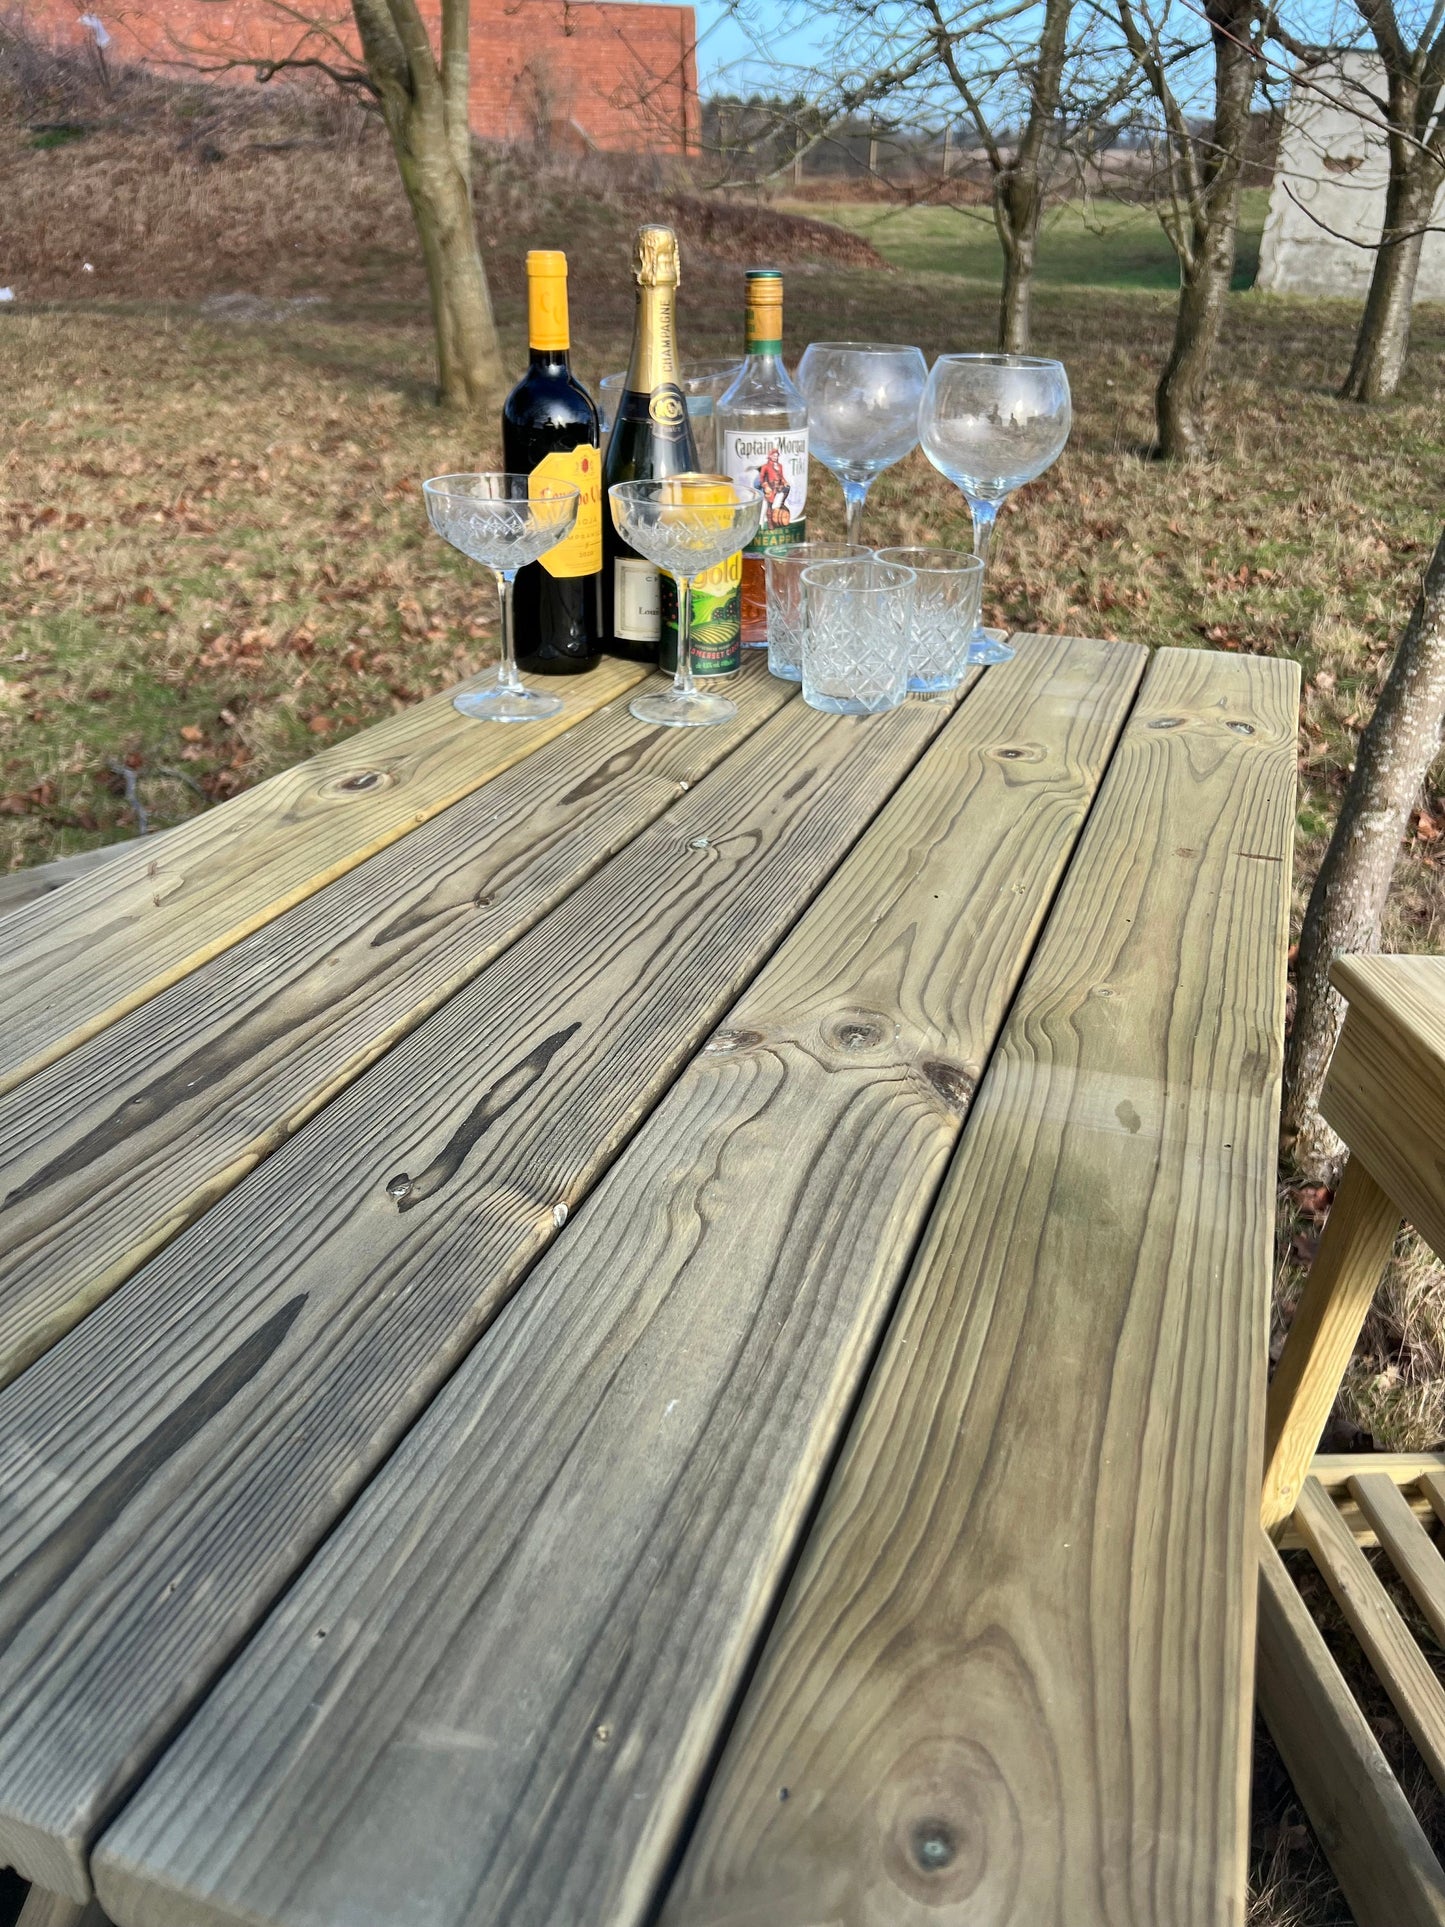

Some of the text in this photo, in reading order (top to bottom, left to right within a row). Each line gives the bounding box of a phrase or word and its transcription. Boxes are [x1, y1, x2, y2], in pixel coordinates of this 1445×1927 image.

[660, 301, 673, 373] CHAMPAGNE
[735, 436, 806, 460] Captain Morgan
[578, 518, 598, 526] IOJA
[693, 554, 740, 590] gold
[690, 648, 725, 659] OMERSET
